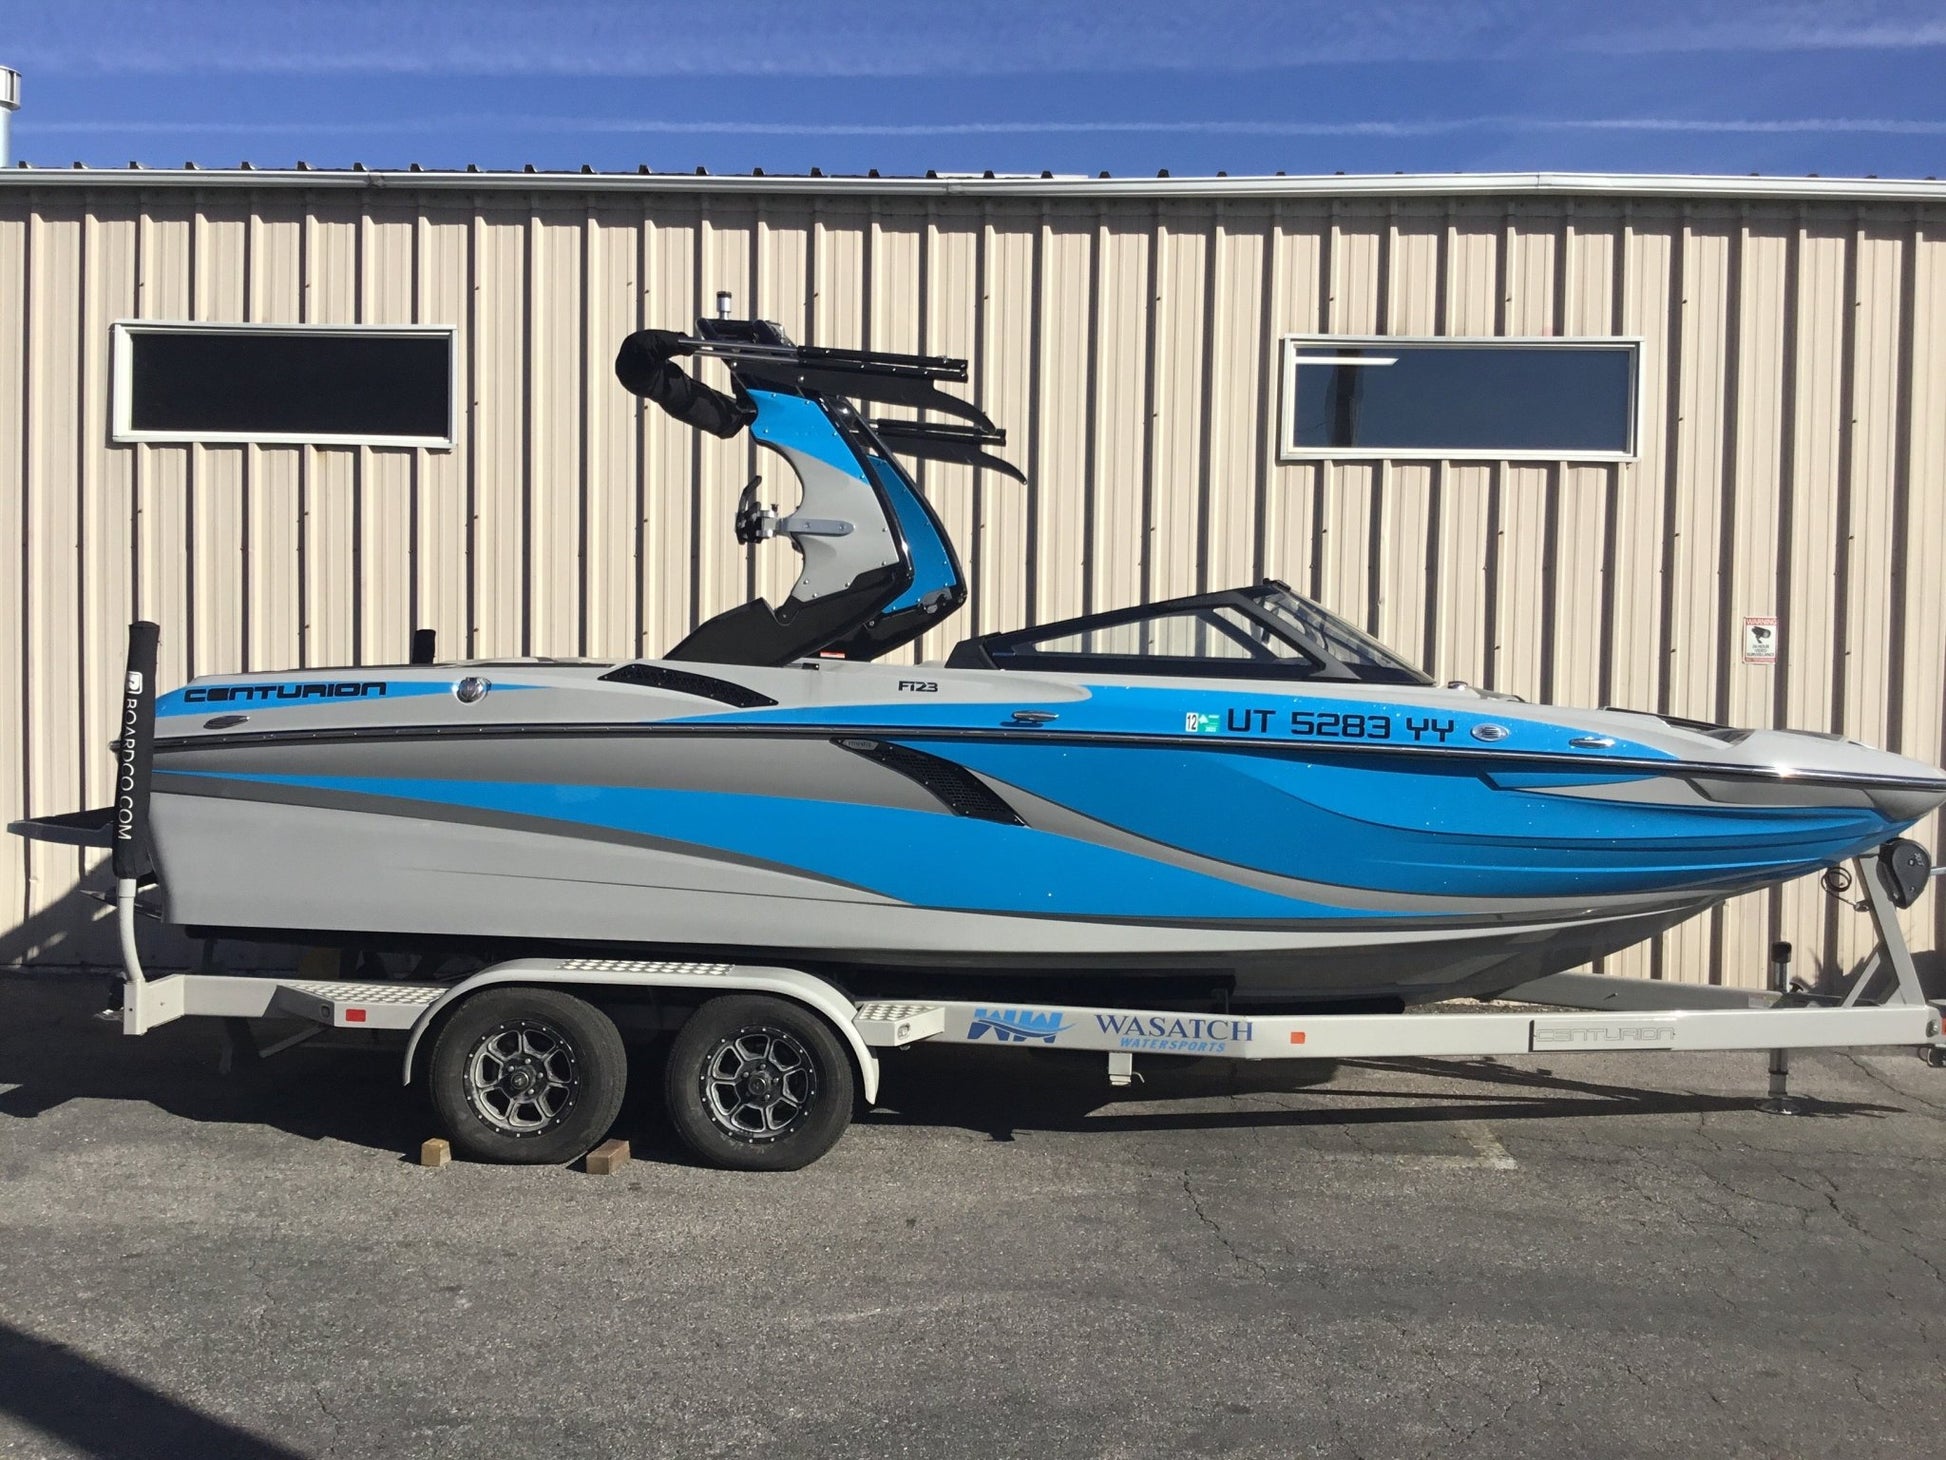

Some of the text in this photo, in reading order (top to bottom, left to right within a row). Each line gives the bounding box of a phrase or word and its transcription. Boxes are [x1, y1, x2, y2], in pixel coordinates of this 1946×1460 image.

[184, 681, 387, 703] CENTURION
[1187, 714, 1197, 731] 12
[1227, 708, 1455, 743] UT 5283 YY
[1094, 1014, 1254, 1042] WASATCH
[1535, 1026, 1676, 1042] CENTURION
[1120, 1037, 1227, 1053] WATERSPORTS
